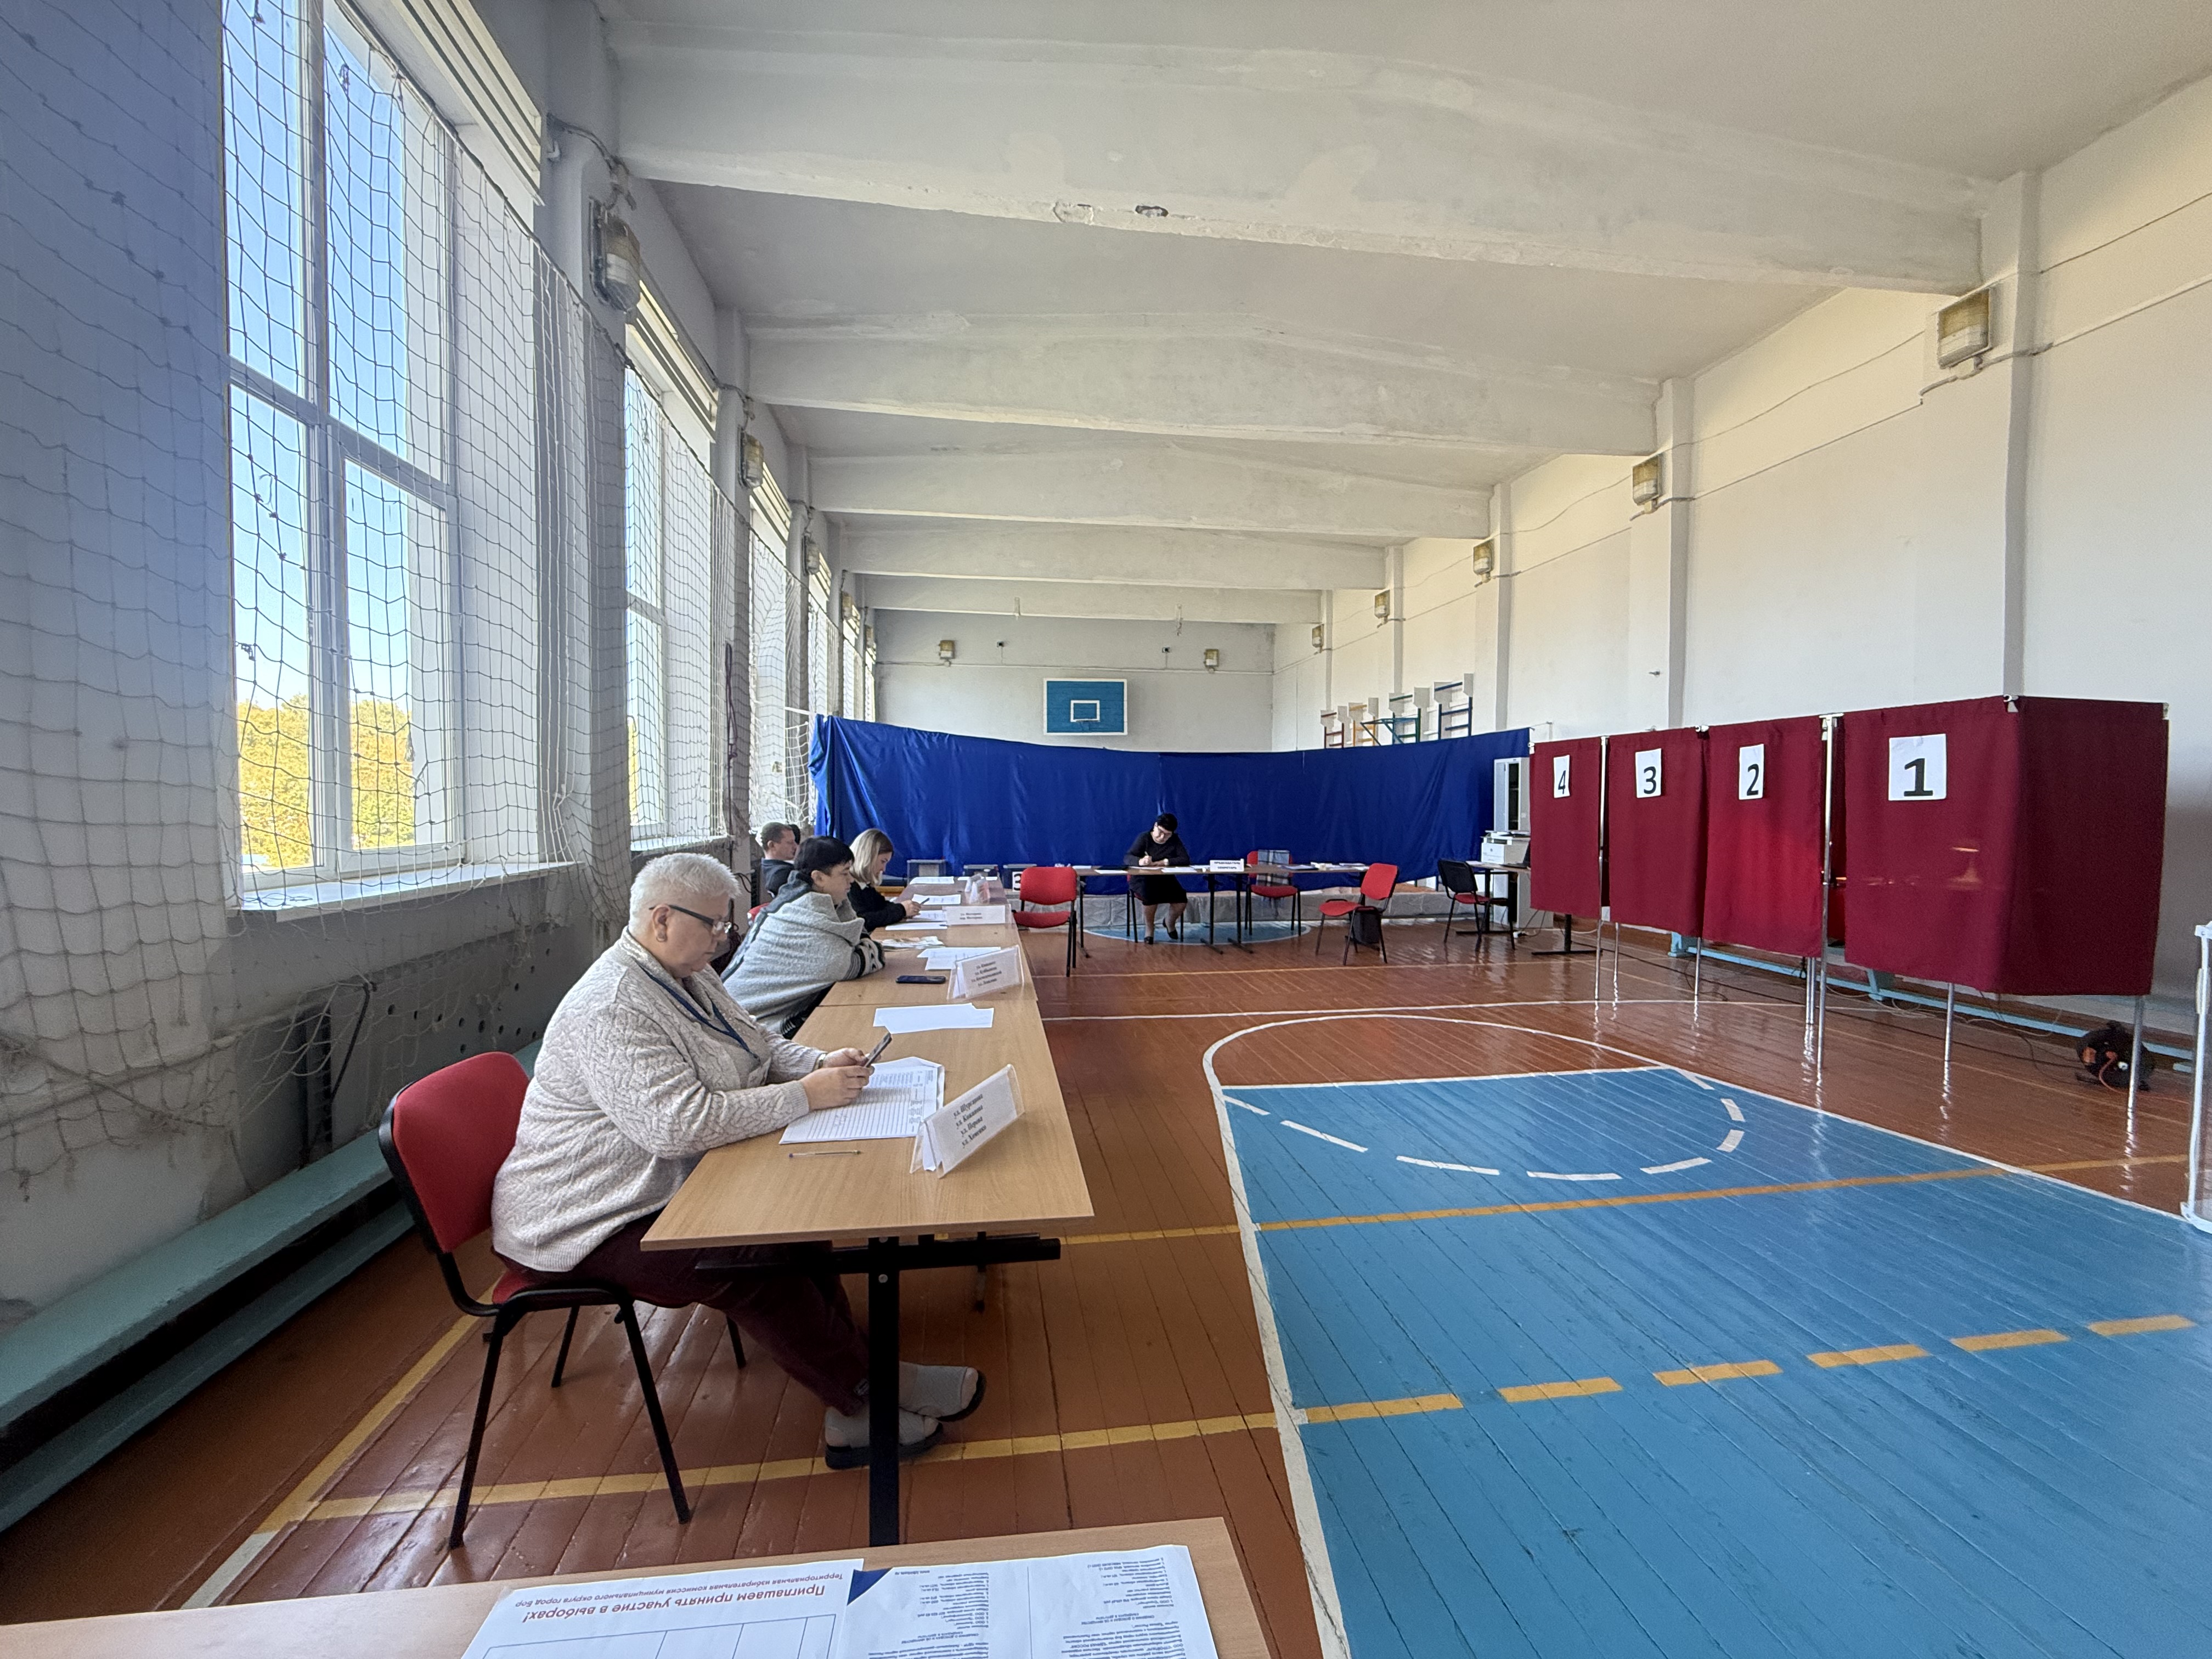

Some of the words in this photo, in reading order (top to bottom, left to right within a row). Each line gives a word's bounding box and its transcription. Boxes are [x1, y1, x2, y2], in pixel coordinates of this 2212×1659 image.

[1557, 769, 1566, 794] 4
[1643, 765, 1657, 794] 3
[1746, 764, 1760, 796] 2
[1904, 758, 1933, 797] 1
[709, 1579, 770, 1591] избирательная
[772, 1573, 843, 1585] Территориальная
[595, 1588, 664, 1601] муниципального
[666, 1585, 707, 1595] комиссия
[736, 1584, 825, 1601] Приглашаем
[515, 1600, 533, 1609] Бор
[536, 1597, 562, 1606] город
[564, 1594, 593, 1605] округа
[612, 1598, 670, 1613] участие
[675, 1592, 733, 1607] принять
[522, 1607, 596, 1623] выборах!
[600, 1606, 608, 1614] в
